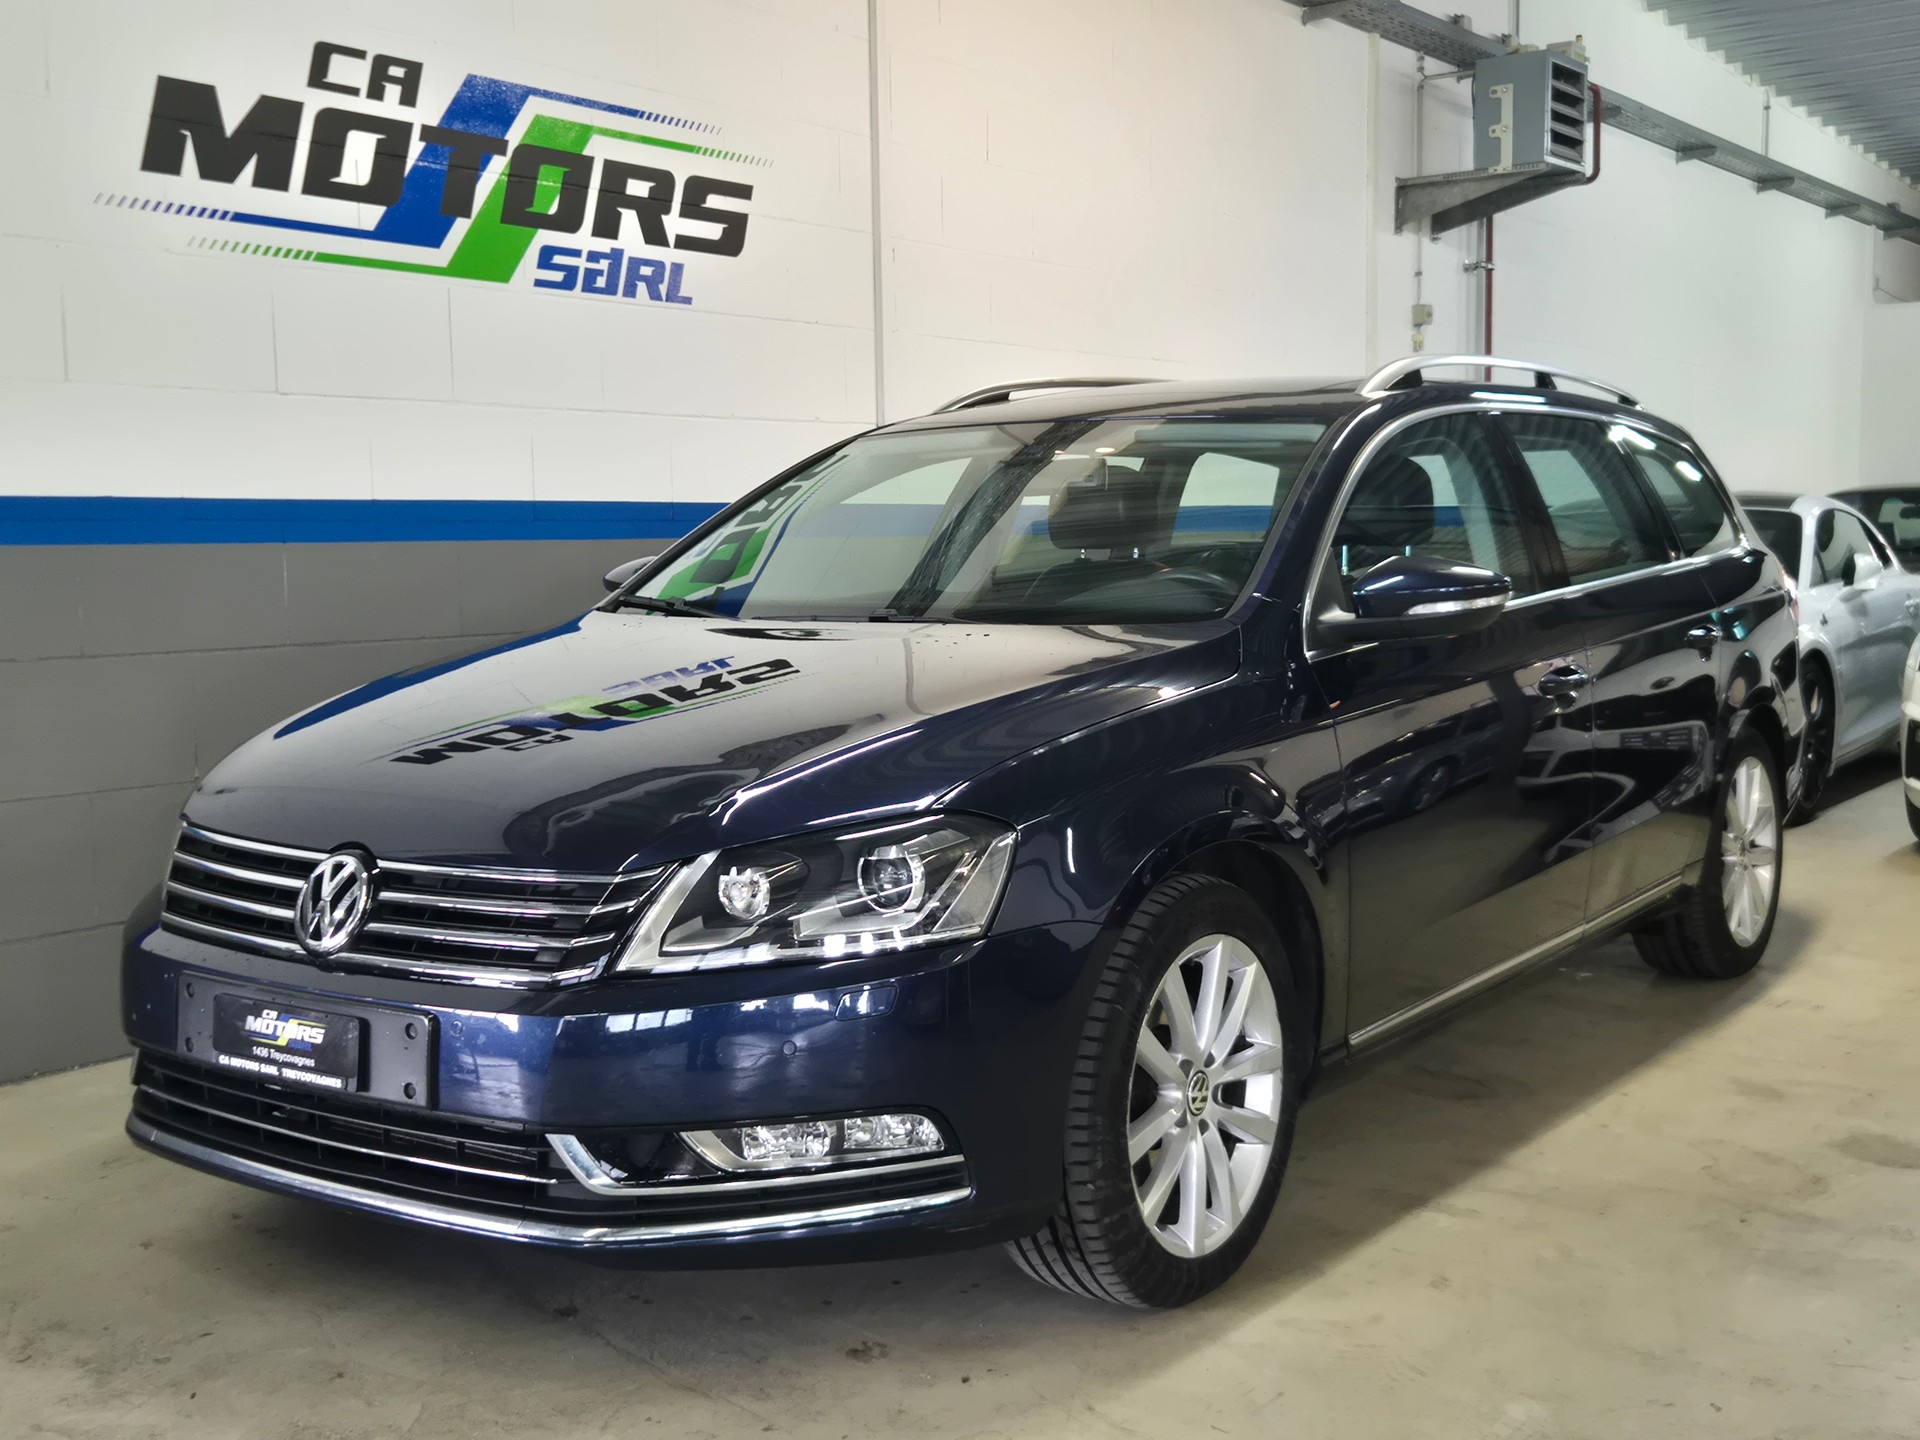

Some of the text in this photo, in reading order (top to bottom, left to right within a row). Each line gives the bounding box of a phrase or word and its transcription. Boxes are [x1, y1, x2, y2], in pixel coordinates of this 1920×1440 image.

[307, 40, 424, 108] CA
[140, 75, 754, 258] MOTORS
[245, 1015, 325, 1044] MOTORS
[262, 1009, 278, 1020] CA
[218, 1054, 342, 1088] CA MOTORS SARL TREYCOVAGNES
[269, 1049, 315, 1067] Treycovagnes
